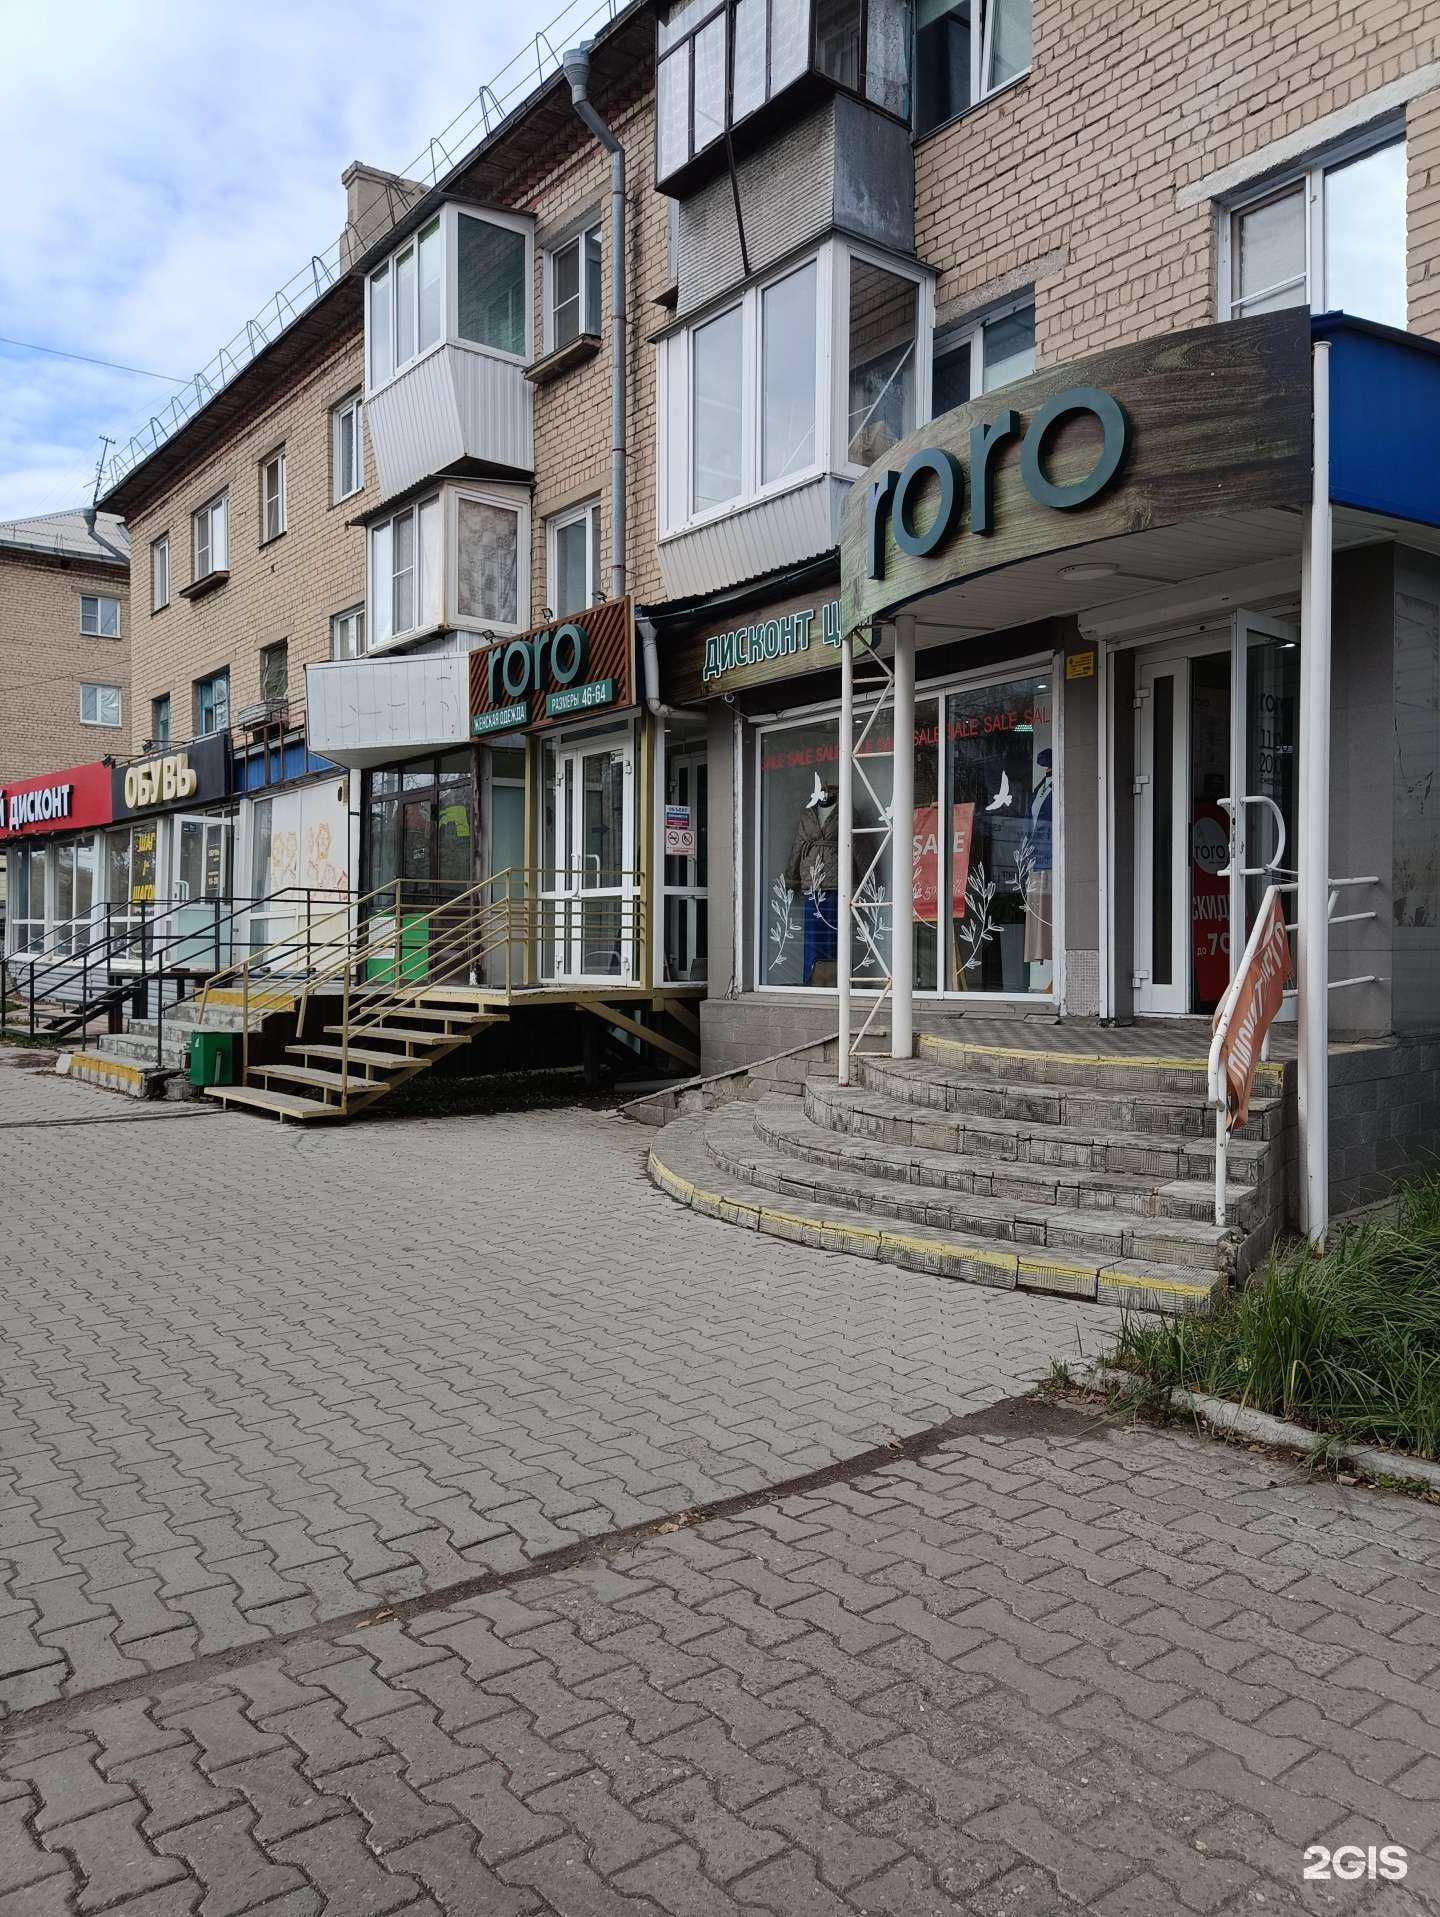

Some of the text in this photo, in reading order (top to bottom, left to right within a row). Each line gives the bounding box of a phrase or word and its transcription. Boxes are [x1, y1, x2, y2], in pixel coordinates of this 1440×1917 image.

[866, 387, 1130, 581] roro
[488, 623, 587, 703] roro
[703, 609, 815, 681] ДИСКОНТ
[474, 704, 525, 731] ЖЕНСКАЯ ОДЕЖДА
[551, 682, 606, 712] РАЗМЕРЫ 46-64
[983, 711, 1018, 735] SALE
[1023, 704, 1051, 726] SAL
[125, 753, 196, 809] ОБУВЬ
[9, 784, 71, 831] ДИСКОНТ
[912, 831, 966, 856] SAE
